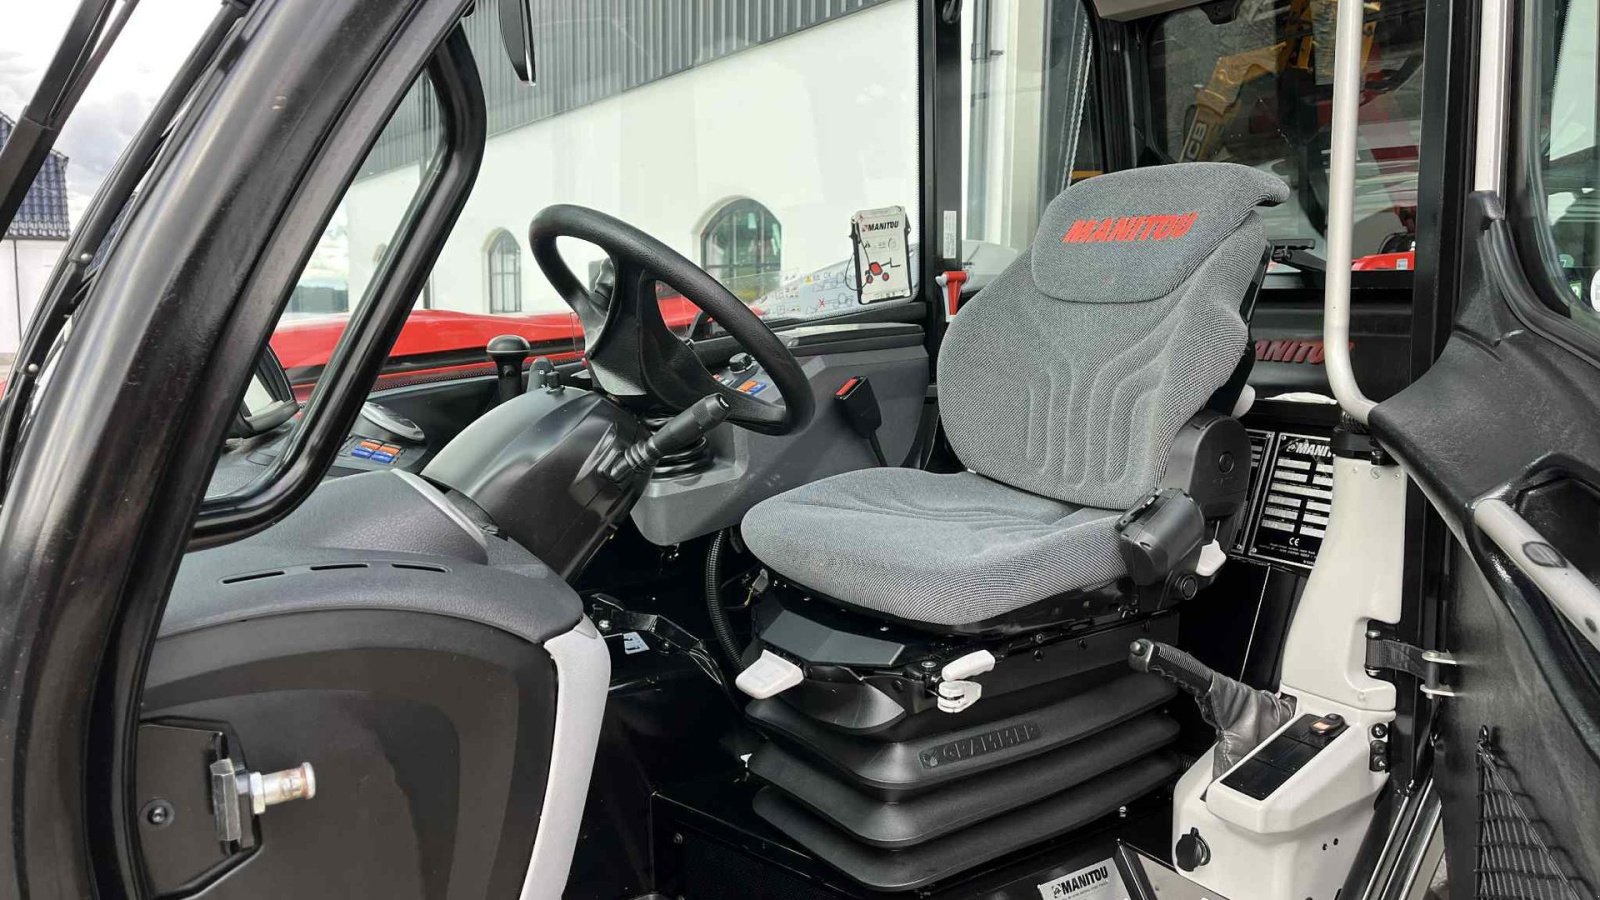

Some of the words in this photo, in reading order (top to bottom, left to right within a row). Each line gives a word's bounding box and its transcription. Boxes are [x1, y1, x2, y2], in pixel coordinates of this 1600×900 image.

[868, 220, 899, 231] MANITOU
[1062, 211, 1198, 243] MANITOU
[1061, 866, 1108, 895] MANITOU
